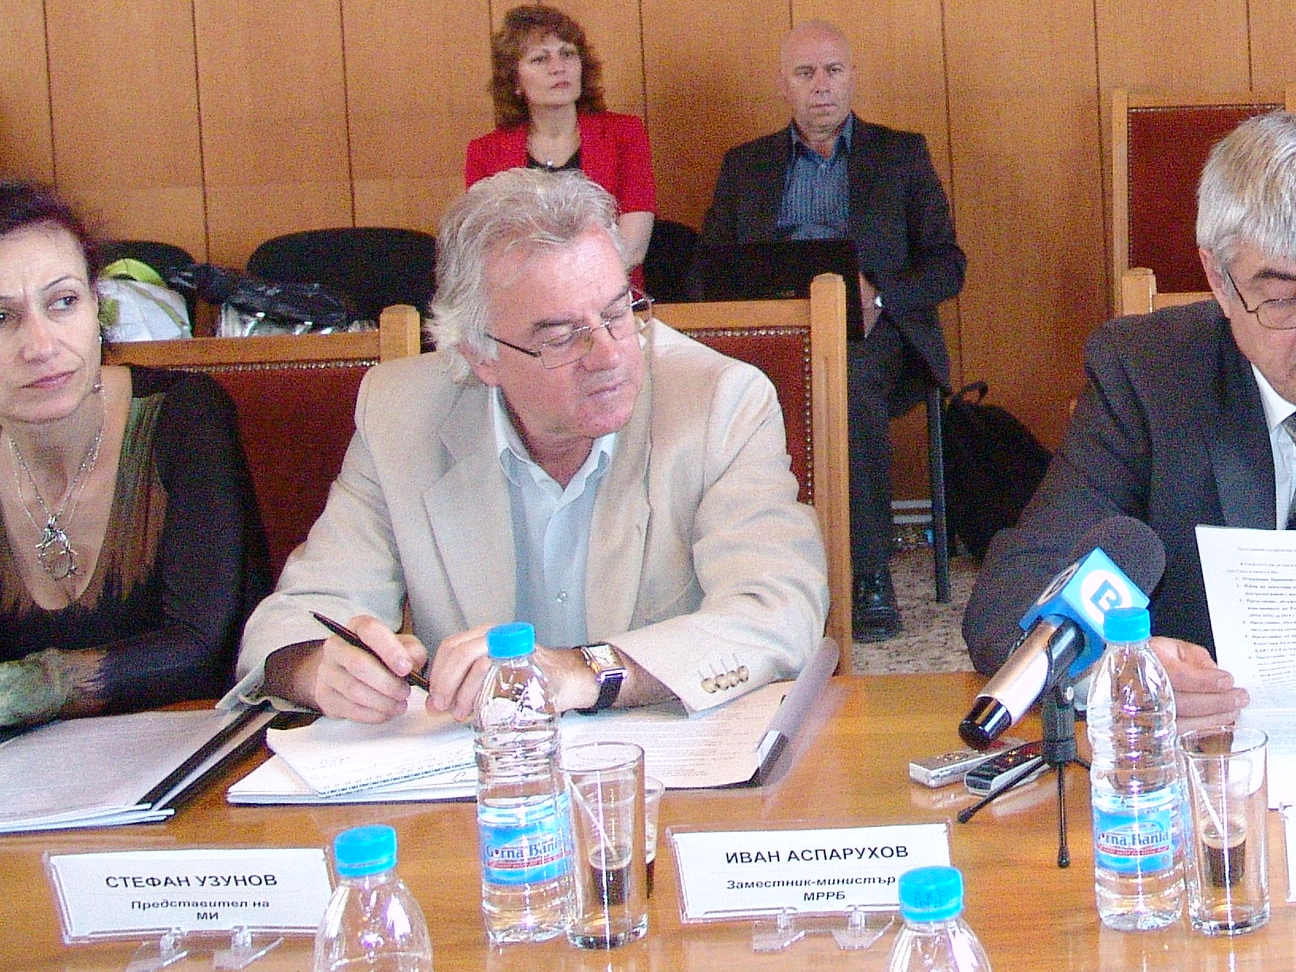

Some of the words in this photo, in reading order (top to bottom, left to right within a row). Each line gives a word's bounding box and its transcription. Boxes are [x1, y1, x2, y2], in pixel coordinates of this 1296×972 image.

[726, 850, 780, 864] ИВАН
[787, 846, 909, 862] АСПАРУХОВ
[105, 876, 191, 888] СТЕФАН
[195, 874, 278, 887] УЗУНОВ
[727, 876, 896, 890] Заместник-министър
[803, 891, 846, 901] МРРБ
[131, 900, 249, 911] Представител
[252, 900, 270, 908] на
[196, 912, 219, 921] МИ
